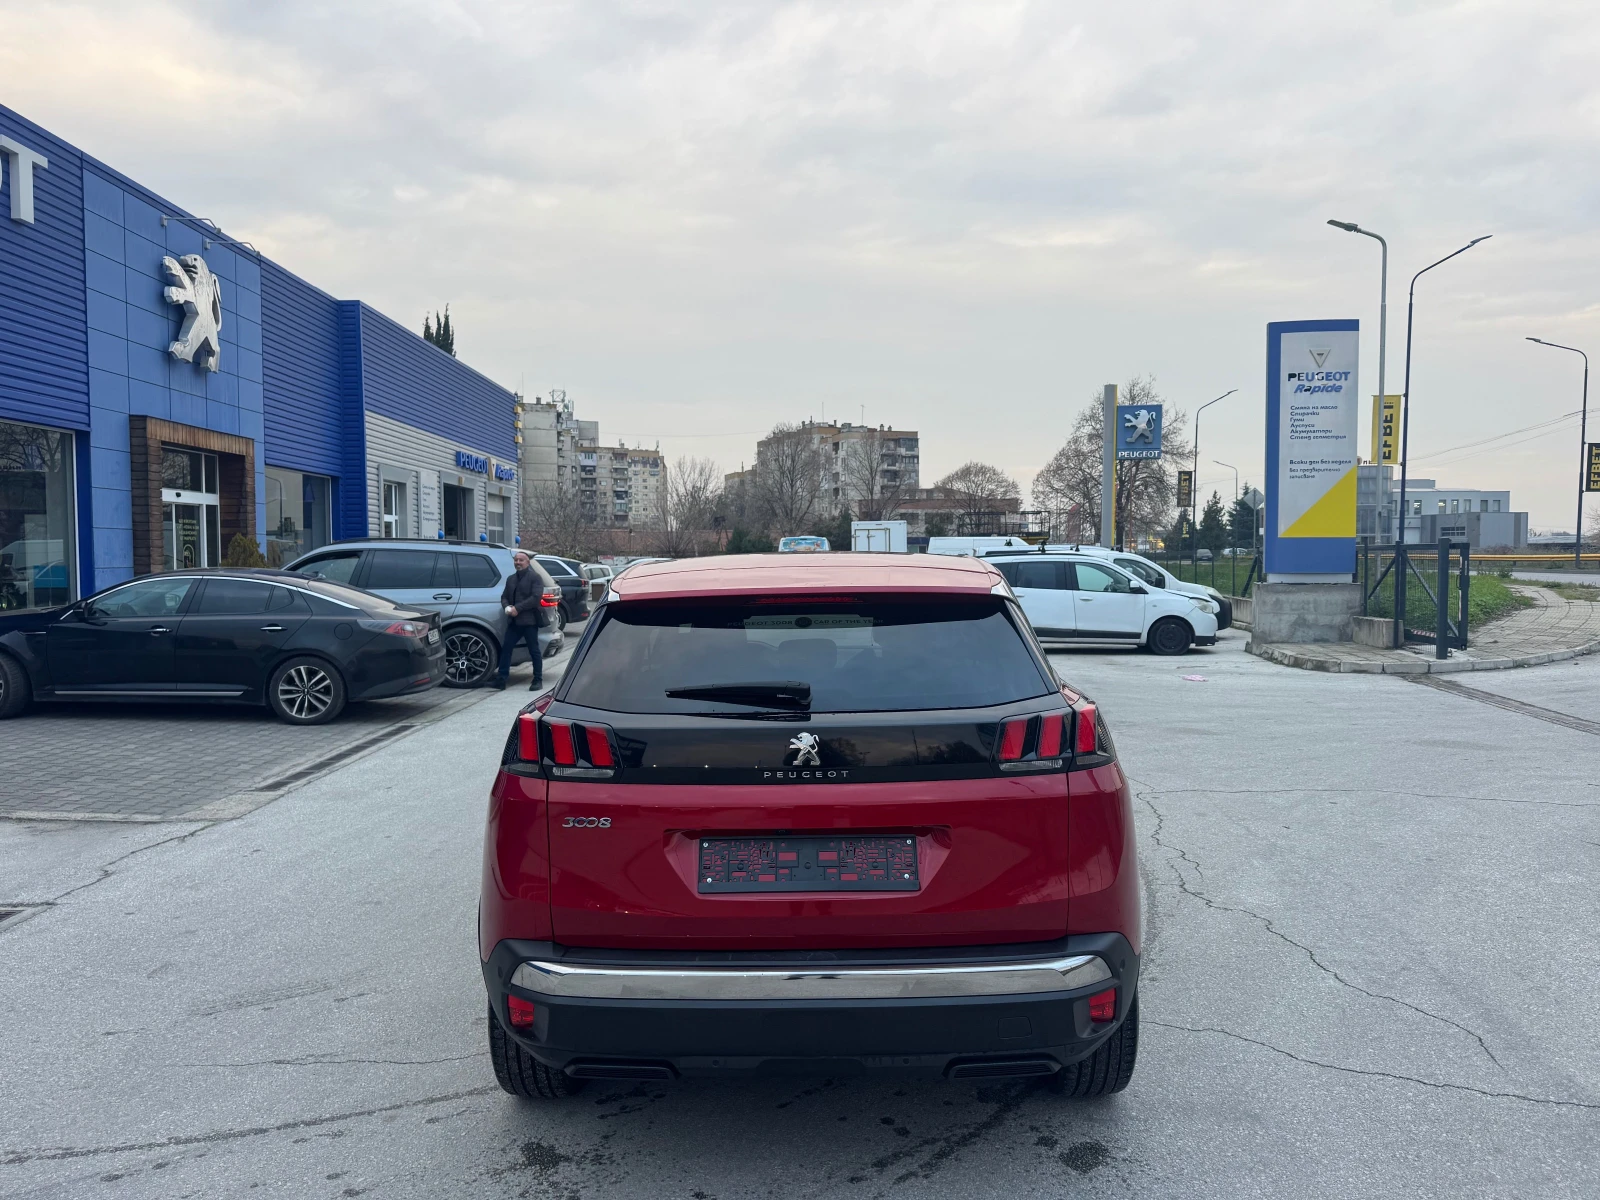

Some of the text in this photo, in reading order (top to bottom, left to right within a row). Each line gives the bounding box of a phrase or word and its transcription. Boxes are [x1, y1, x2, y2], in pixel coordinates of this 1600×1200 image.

[1288, 371, 1350, 381] PEUGEOT
[1294, 383, 1343, 394] Rapide
[1118, 450, 1160, 458] PEUGEOT
[456, 451, 488, 474] PEUGEOT
[763, 770, 849, 778] PEUGEOT
[562, 816, 612, 828] 3008
